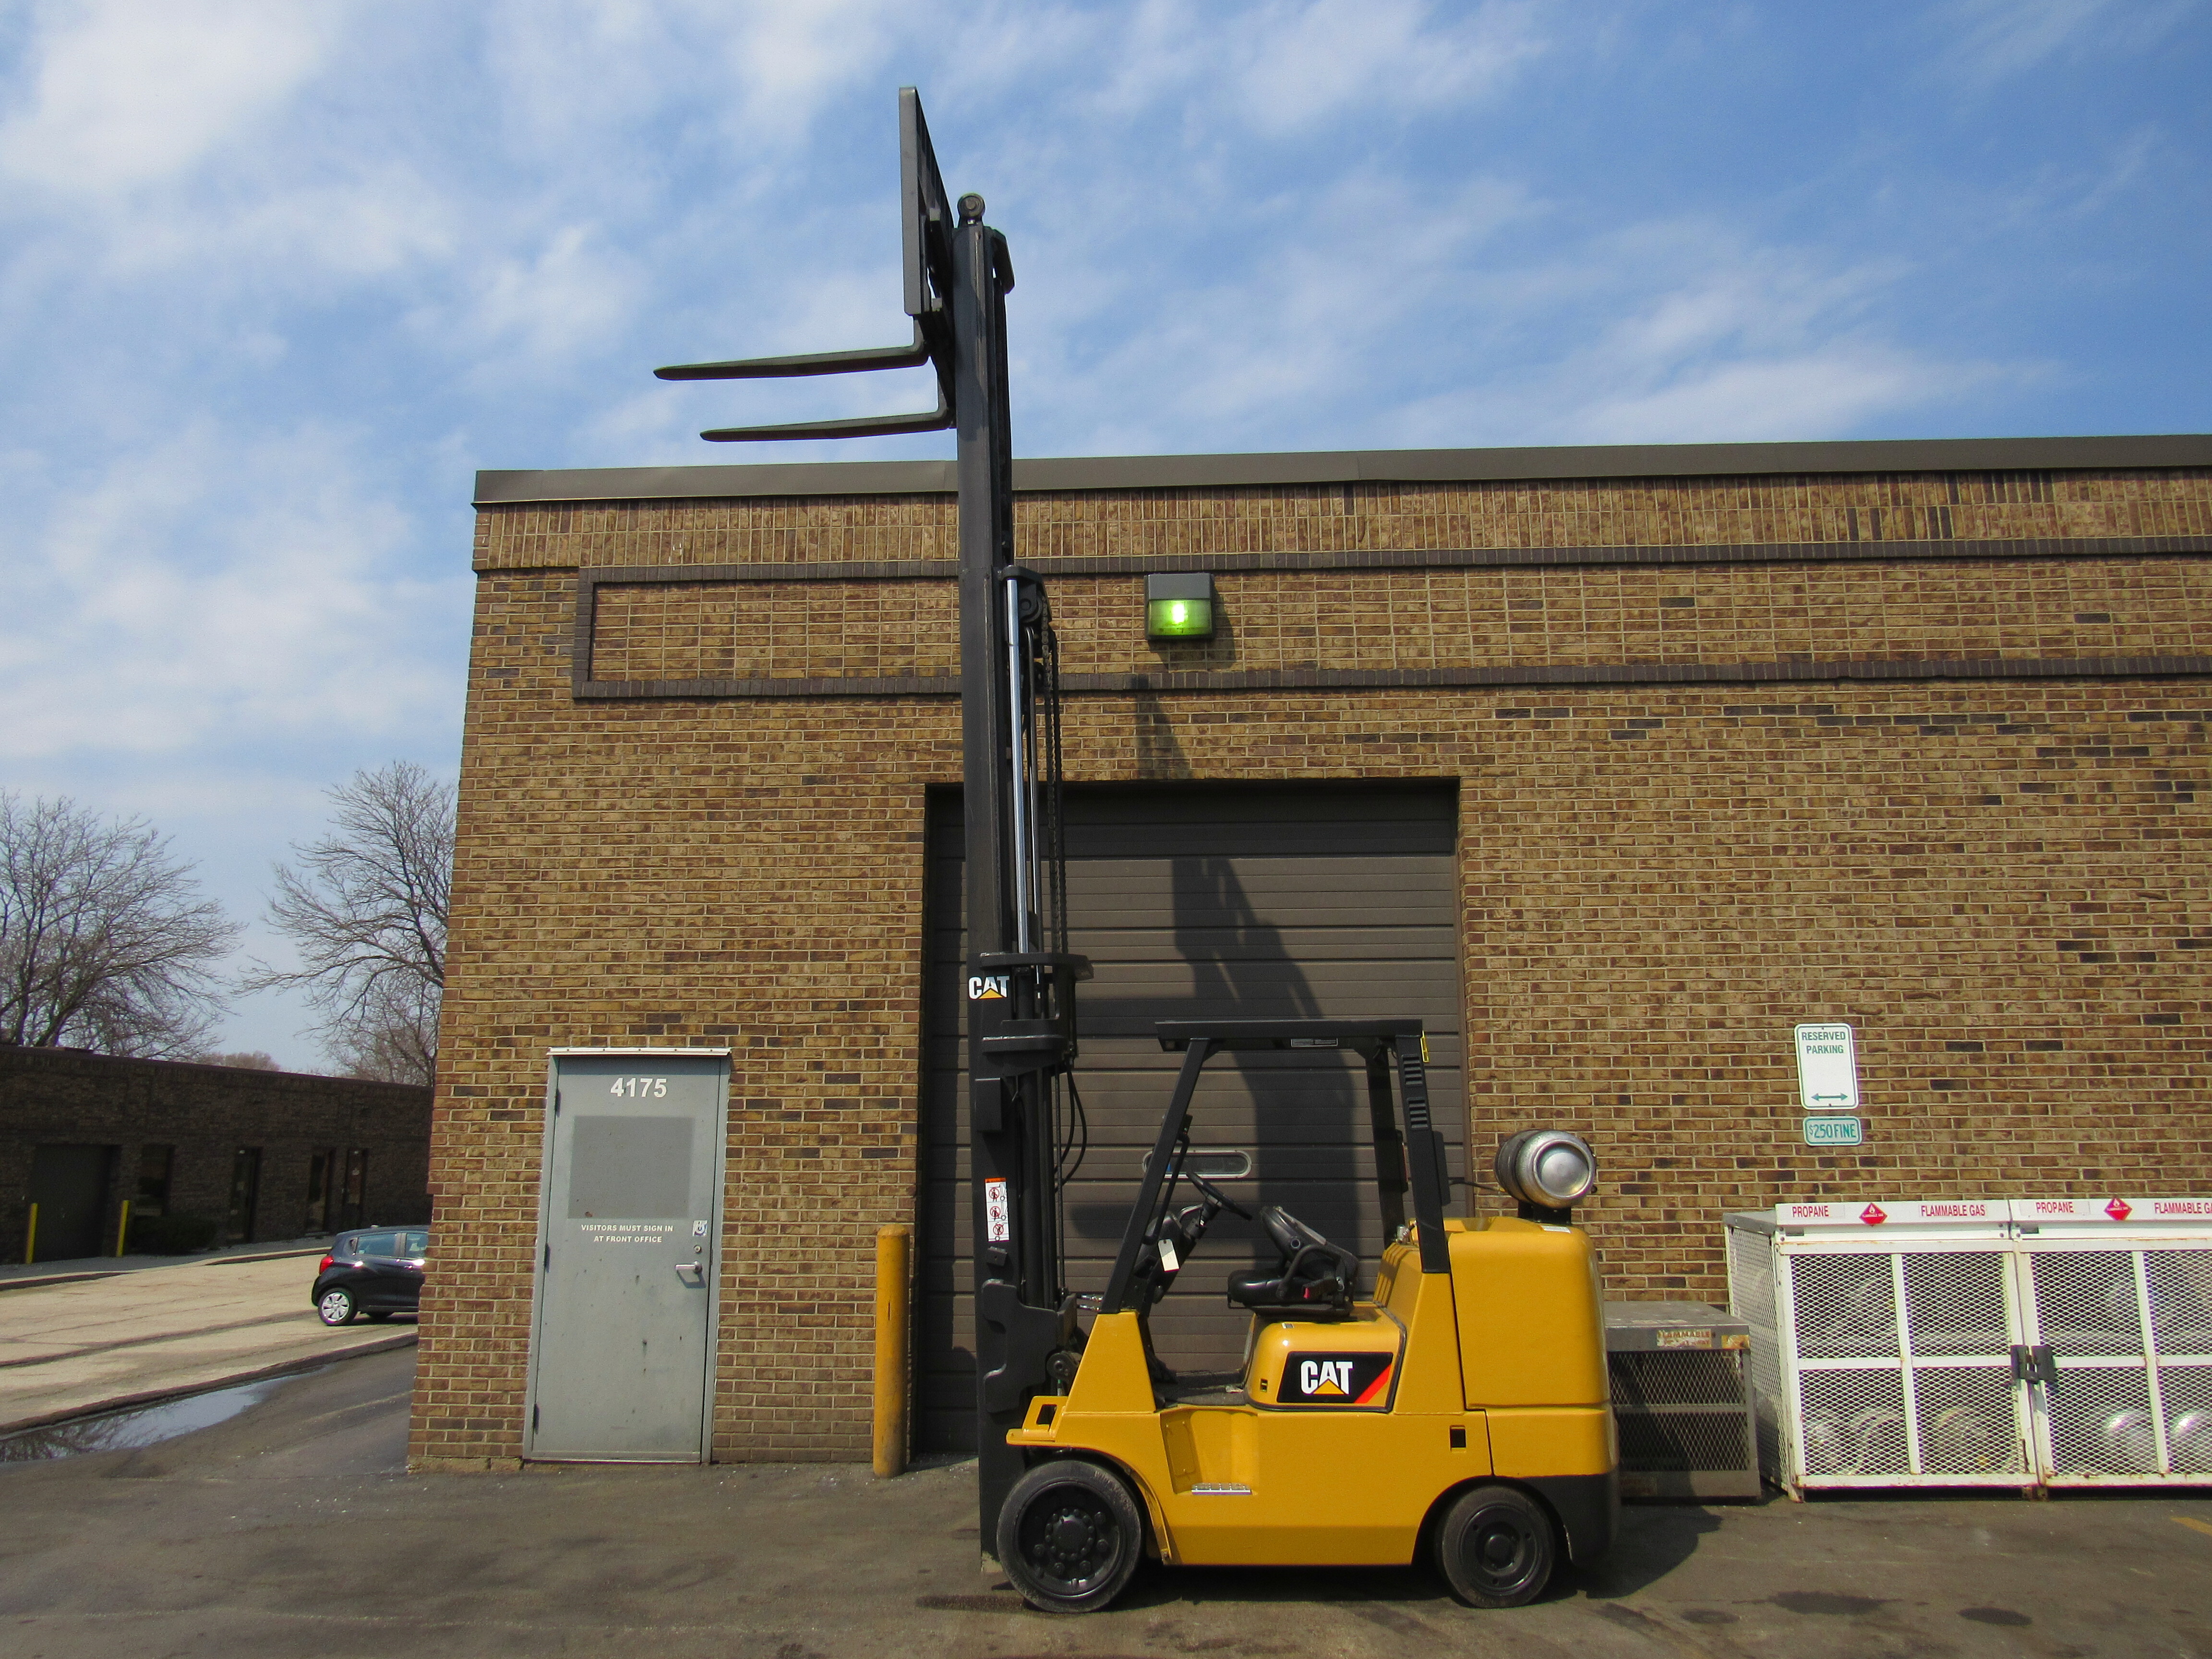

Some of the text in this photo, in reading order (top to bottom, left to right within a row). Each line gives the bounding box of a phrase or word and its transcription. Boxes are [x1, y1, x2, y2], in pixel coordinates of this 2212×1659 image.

[969, 976, 1010, 999] CAT
[1802, 1032, 1846, 1041] RESERVED
[1806, 1045, 1844, 1054] PARKING
[610, 1078, 668, 1098] 4175
[1792, 1205, 1829, 1217] PROPANE
[1921, 1205, 1986, 1216] FLAMMABLE GAS
[2036, 1202, 2074, 1213] PROPANE
[2154, 1202, 2202, 1214] FLAMMABLE
[1300, 1360, 1353, 1395] CAT
